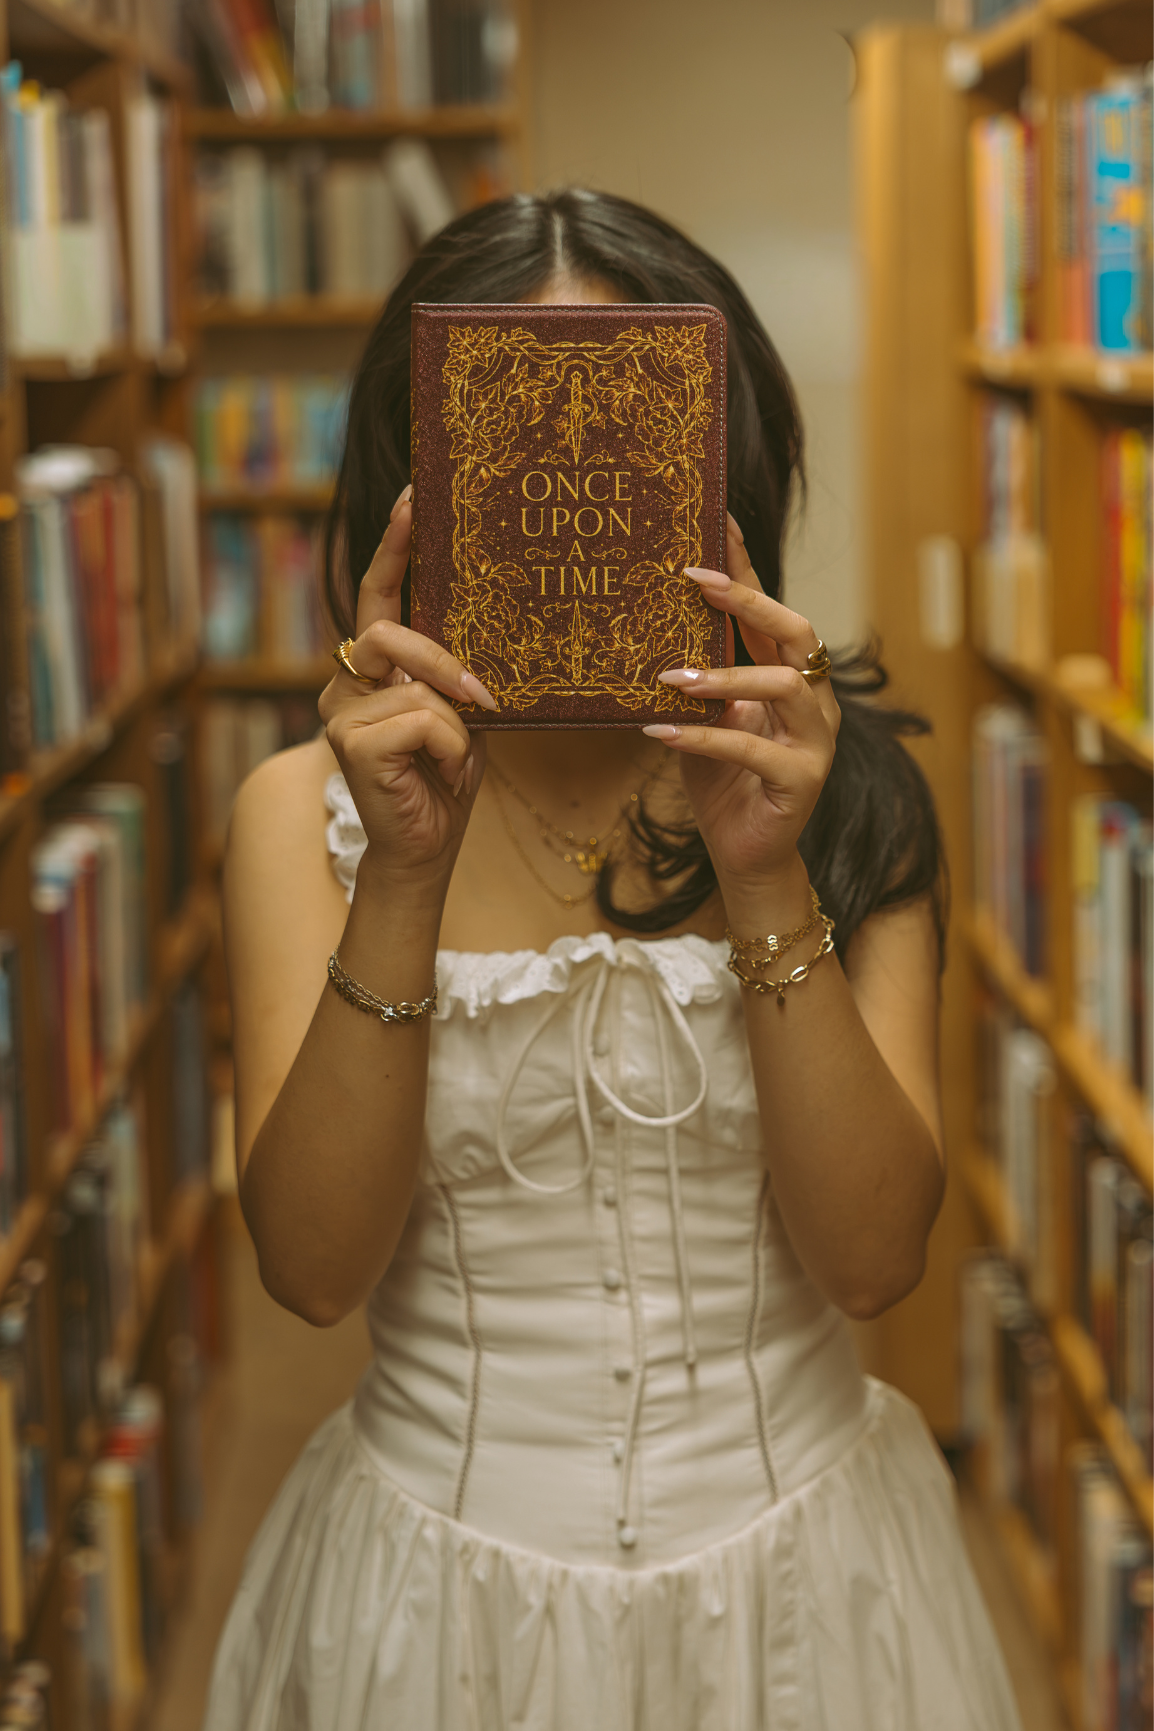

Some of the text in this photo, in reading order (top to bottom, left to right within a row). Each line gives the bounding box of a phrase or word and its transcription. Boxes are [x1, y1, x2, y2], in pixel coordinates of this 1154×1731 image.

[521, 471, 632, 501] ONCE
[521, 507, 632, 537] UPON
[566, 540, 586, 562] A
[532, 566, 621, 596] TIME
